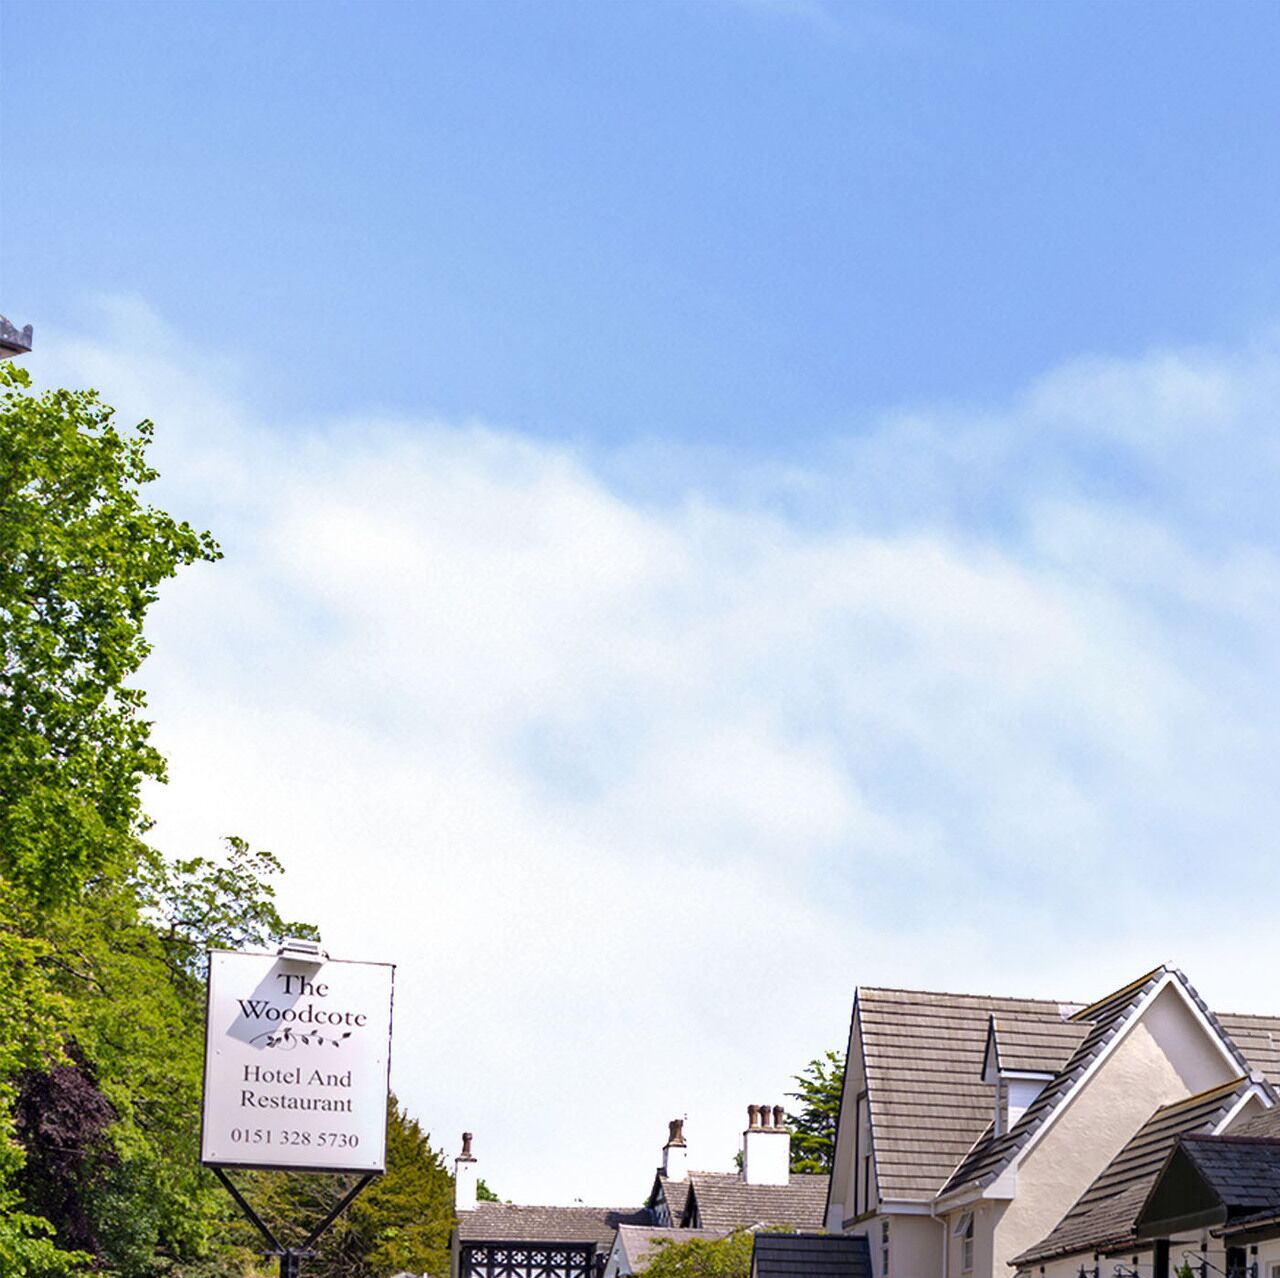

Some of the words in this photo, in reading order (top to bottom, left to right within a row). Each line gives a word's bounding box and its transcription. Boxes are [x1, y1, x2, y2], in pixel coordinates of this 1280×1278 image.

[278, 974, 329, 997] The
[237, 1000, 367, 1027] Woodcote
[243, 1065, 300, 1085] Hotel
[308, 1070, 352, 1088] And
[241, 1090, 352, 1113] Restaurant
[231, 1128, 271, 1143] 0151
[280, 1132, 312, 1146] 328
[317, 1133, 359, 1148] 5730
